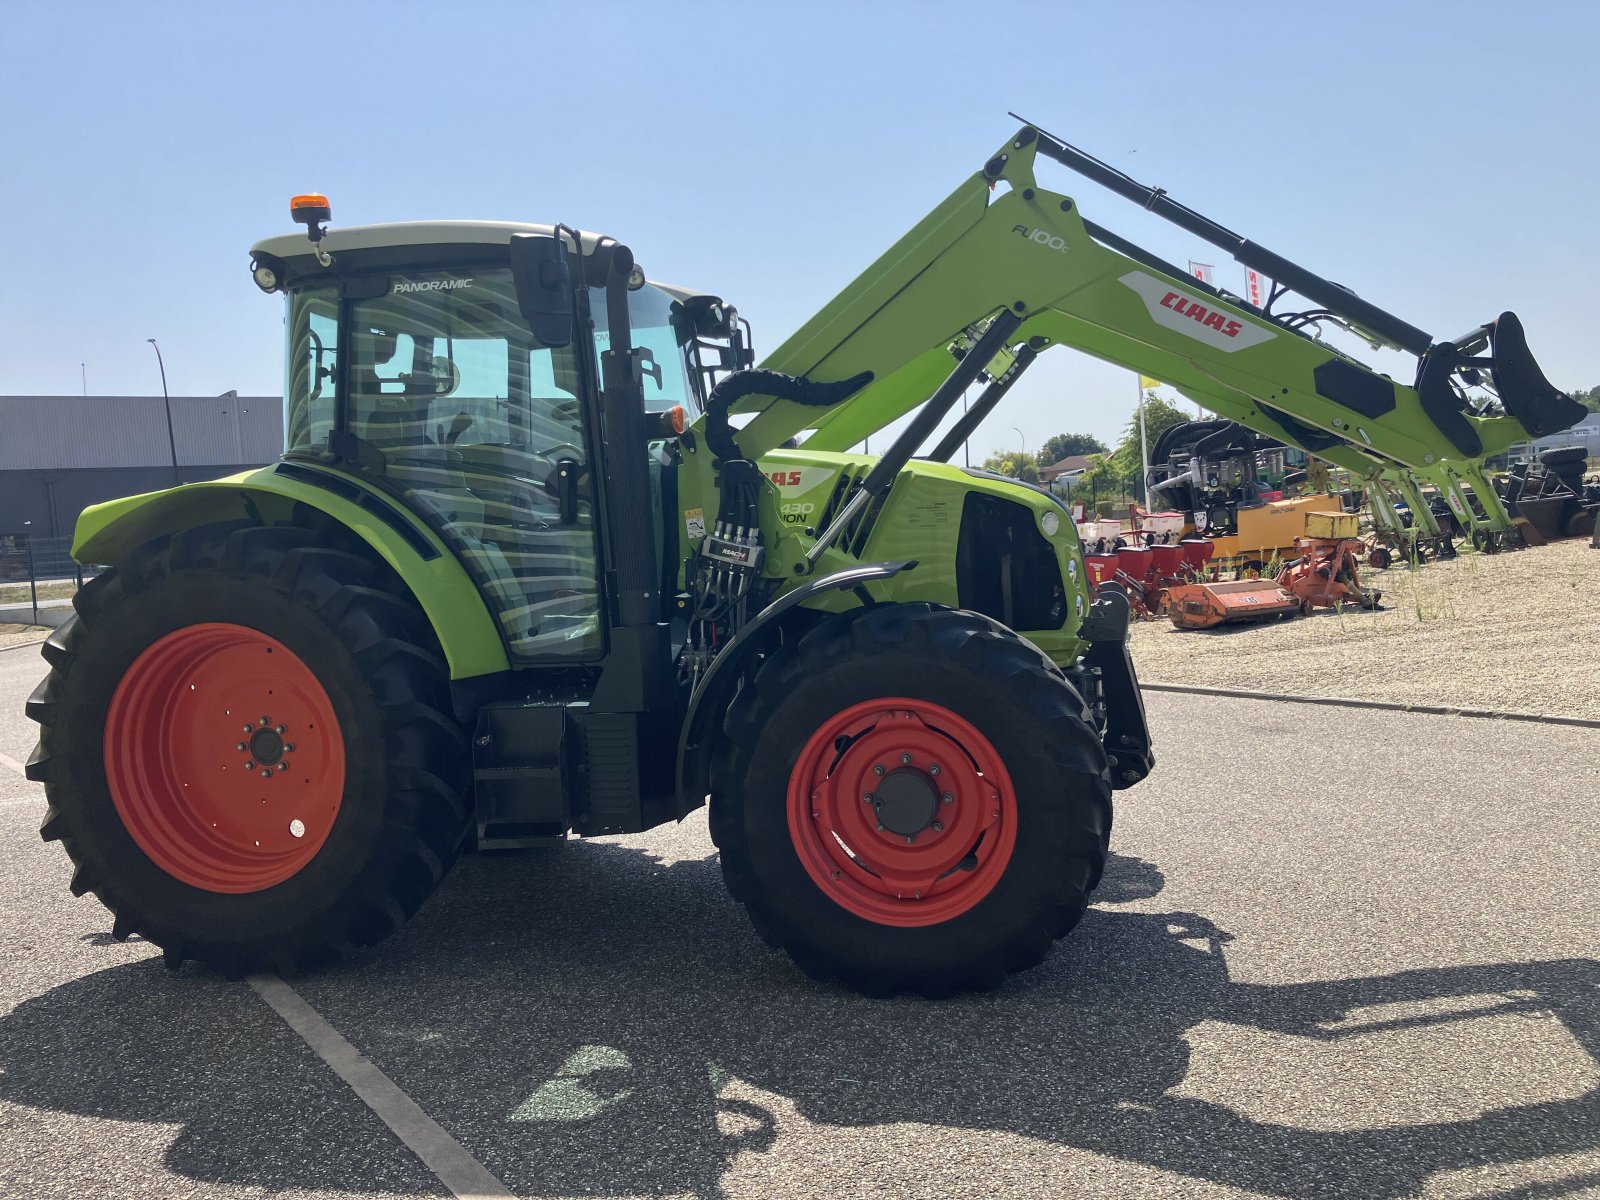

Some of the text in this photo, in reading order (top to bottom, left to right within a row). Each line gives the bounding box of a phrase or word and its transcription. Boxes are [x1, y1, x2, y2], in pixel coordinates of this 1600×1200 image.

[393, 279, 473, 294] PANORAMIC
[1159, 291, 1244, 338] CLAAS
[770, 471, 801, 486] AS
[780, 502, 814, 514] 430
[783, 514, 807, 523] ION
